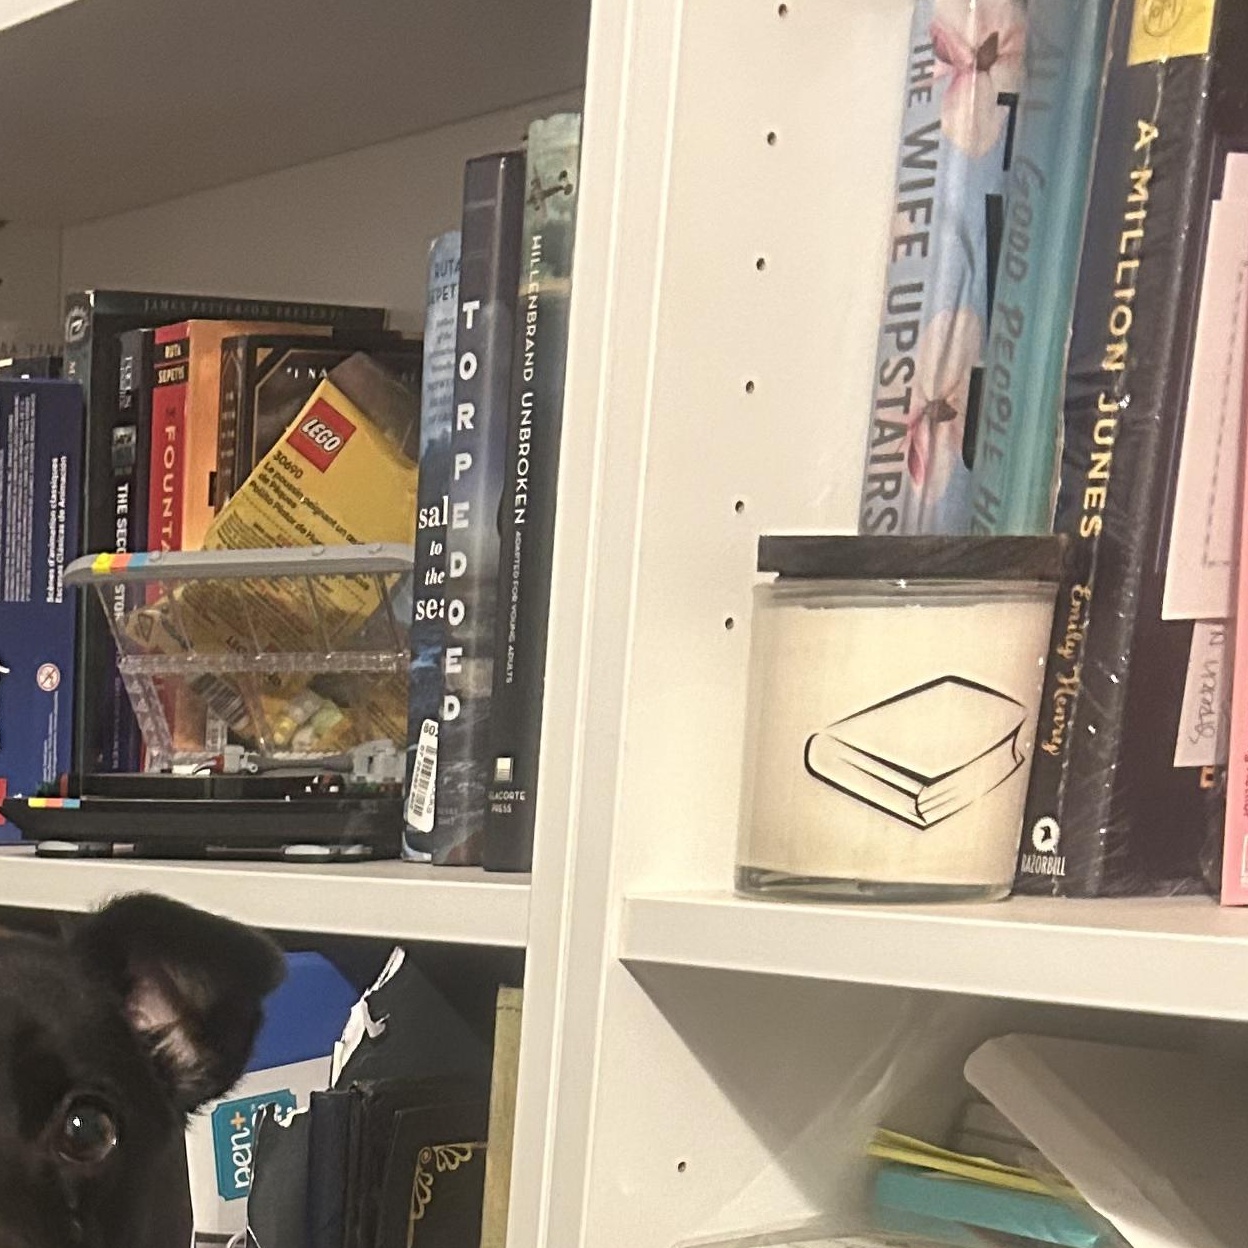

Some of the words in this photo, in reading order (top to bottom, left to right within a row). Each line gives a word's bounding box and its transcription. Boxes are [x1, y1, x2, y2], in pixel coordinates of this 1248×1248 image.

[908, 43, 935, 108] THE
[1134, 119, 1158, 150] A
[892, 120, 942, 263] WIFE
[522, 235, 542, 382] HILLENBRAND
[1101, 168, 1152, 371] MILLION
[862, 281, 924, 534] UPSTAIRS
[984, 303, 1025, 460] PEOPLE
[273, 450, 304, 480] 30690
[301, 418, 342, 453] LEGO
[514, 392, 534, 524] UNBROKEN
[1080, 392, 1119, 538] JUNES
[116, 483, 129, 514] THE
[443, 300, 480, 721] TORPEDOED
[425, 566, 445, 586] the
[429, 540, 443, 557] to
[1056, 584, 1091, 659] Emily
[1042, 663, 1082, 756] Henry
[1021, 853, 1067, 877] RAZORBILL
